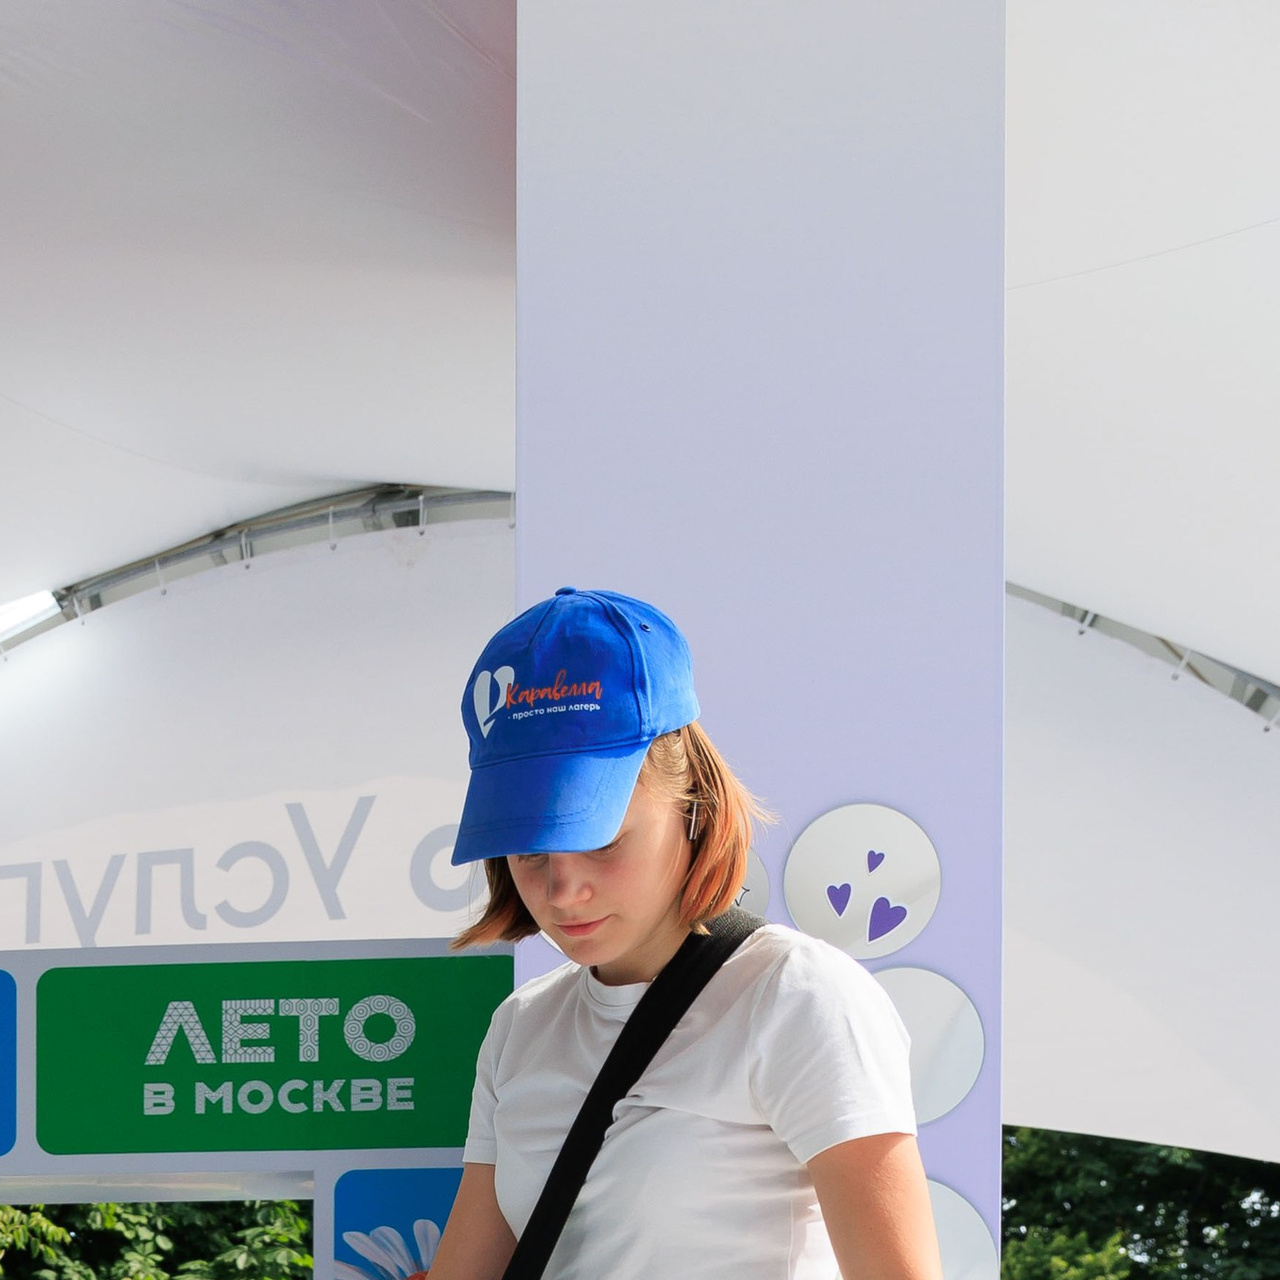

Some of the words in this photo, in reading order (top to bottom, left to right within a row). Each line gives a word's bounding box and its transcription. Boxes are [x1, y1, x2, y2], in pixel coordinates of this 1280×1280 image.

[506, 669, 602, 709] Каравелла
[513, 709, 545, 720] просто
[547, 705, 566, 713] наш
[569, 703, 600, 712] лагерь
[144, 994, 416, 1065] ЛЕТО
[144, 1083, 175, 1115] В
[195, 1077, 414, 1114] МОСКВЕ
